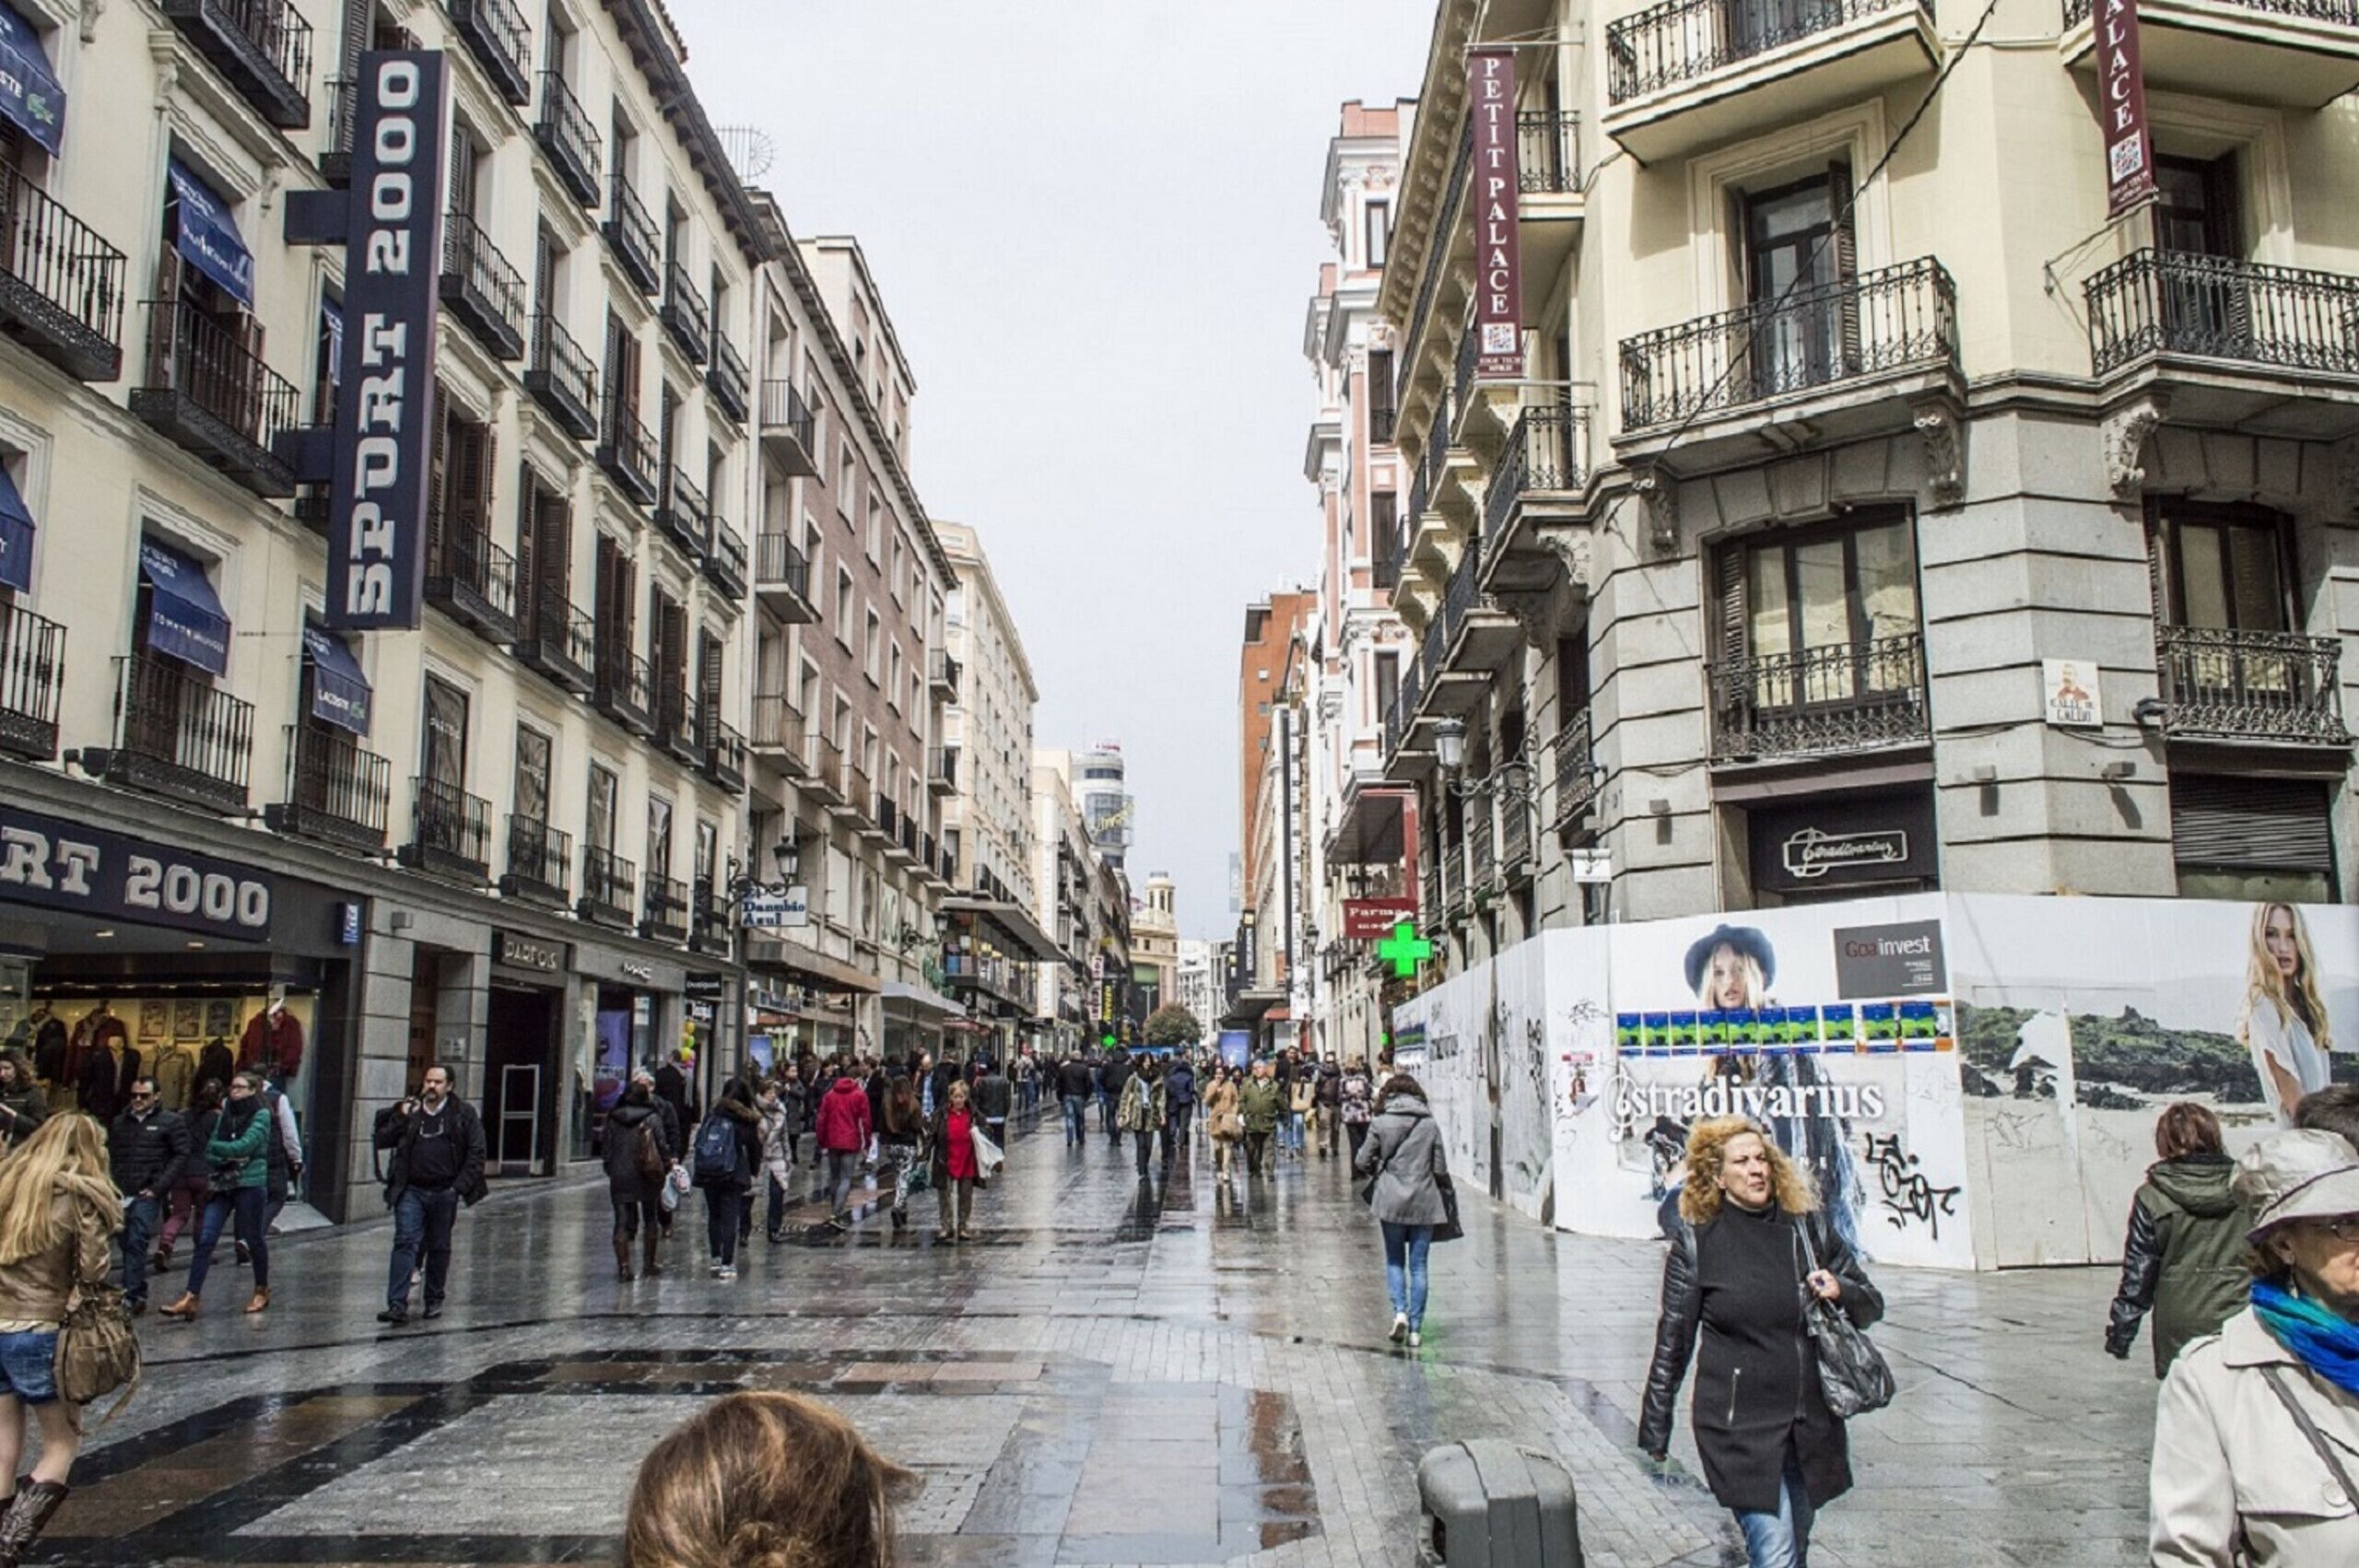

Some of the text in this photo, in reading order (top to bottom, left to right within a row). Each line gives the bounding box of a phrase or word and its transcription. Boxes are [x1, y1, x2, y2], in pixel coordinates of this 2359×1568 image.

[1483, 58, 1508, 314] PETIT PALACE
[346, 59, 420, 615] SPORT 2000
[124, 855, 269, 927] 2000
